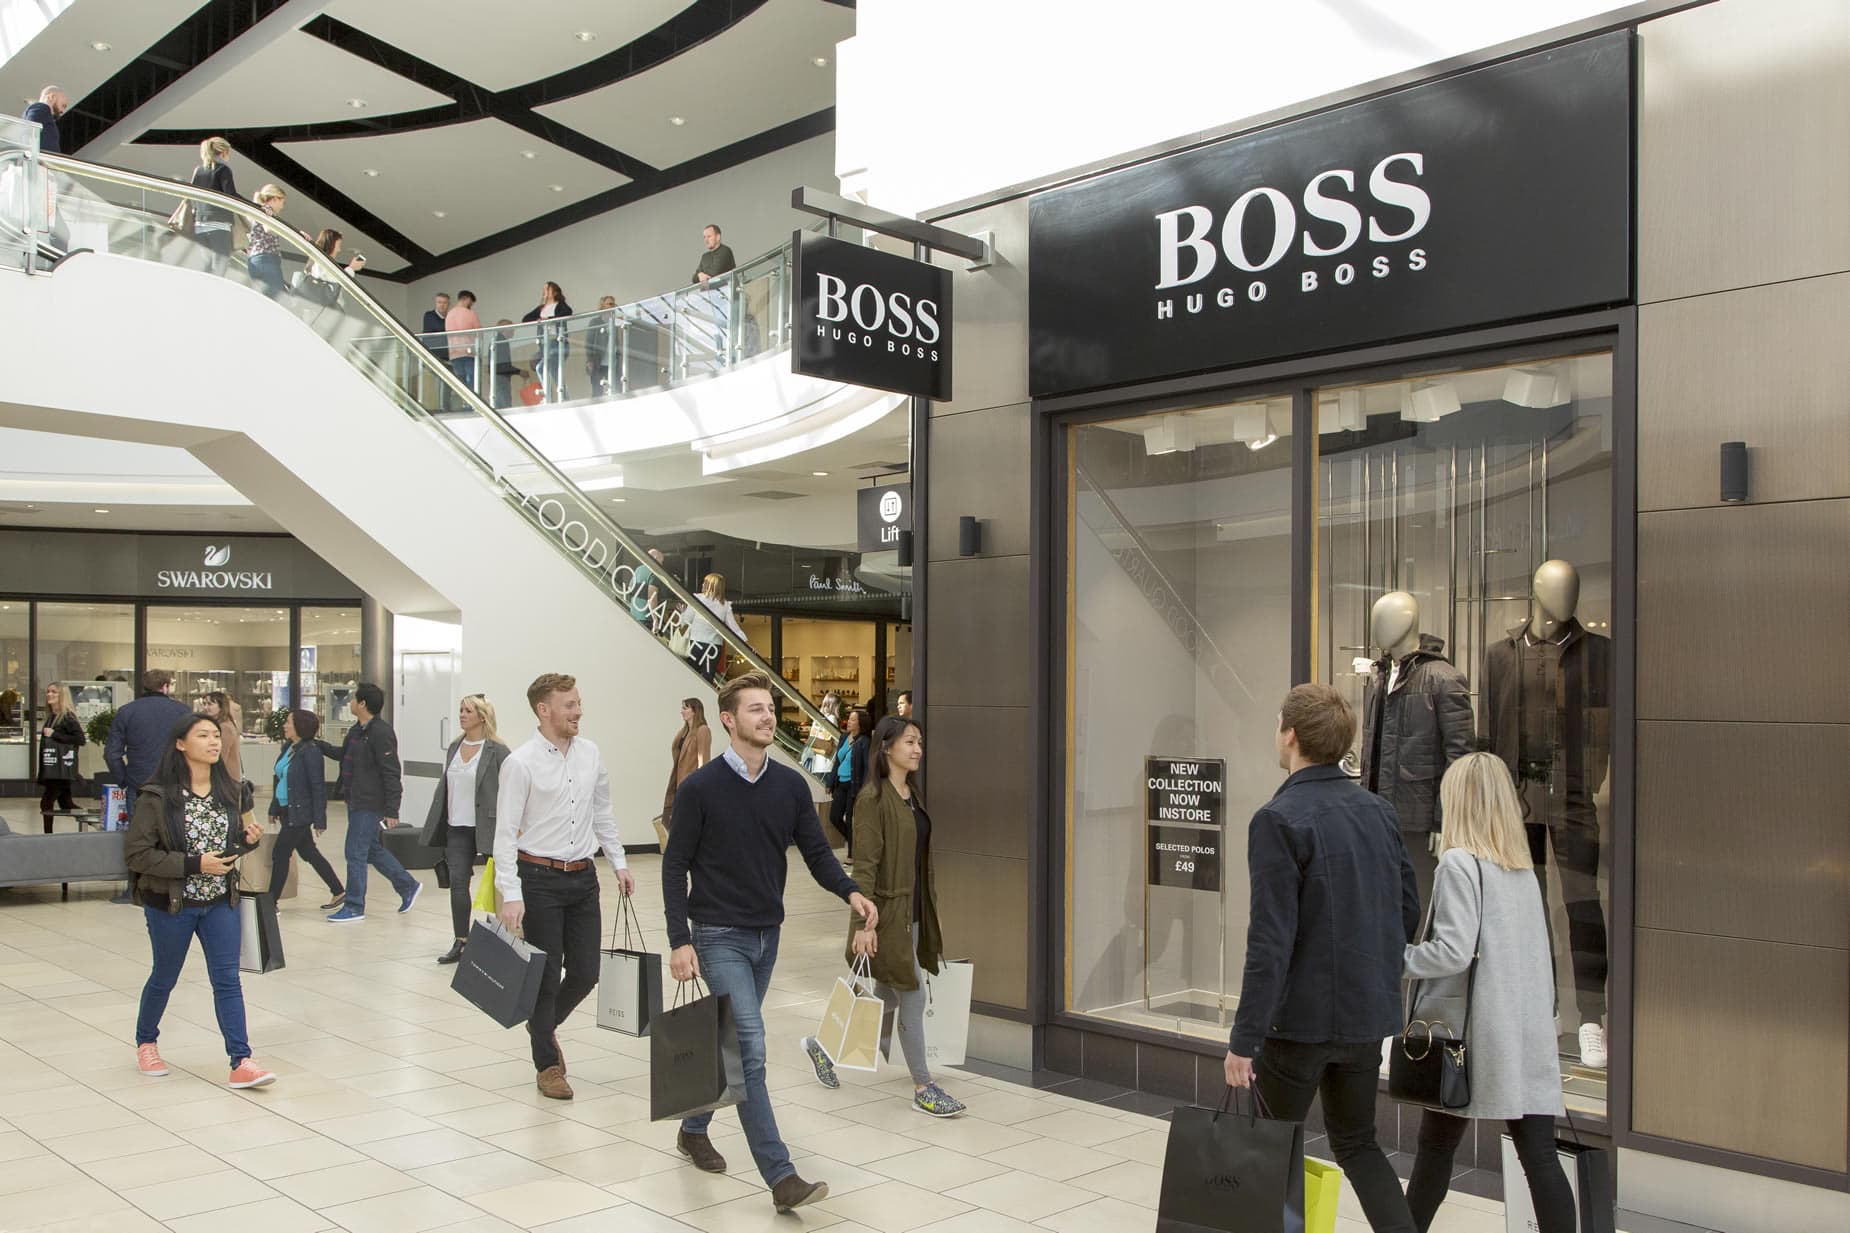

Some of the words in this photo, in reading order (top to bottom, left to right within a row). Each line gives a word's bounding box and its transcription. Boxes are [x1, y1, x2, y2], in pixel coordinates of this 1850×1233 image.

[1155, 152, 1431, 289] BOSS
[1157, 281, 1267, 320] HUGO
[1301, 248, 1427, 292] BOSS
[816, 272, 940, 344] BOSS
[817, 324, 872, 347] HUGO
[887, 340, 938, 362] BOSS
[881, 525, 900, 543] Lift
[157, 570, 272, 589] SWAROVSKI
[809, 574, 833, 590] Paul
[835, 578, 867, 594] Smith
[611, 565, 719, 673] QUARER
[1170, 763, 1199, 775] NEW
[1148, 778, 1222, 793] COLLECTION
[1169, 793, 1200, 806] NOW
[1159, 807, 1212, 822] INSTORE
[1155, 843, 1190, 853] SELECTED
[1191, 845, 1215, 855] POLOS
[1175, 860, 1195, 873] £49
